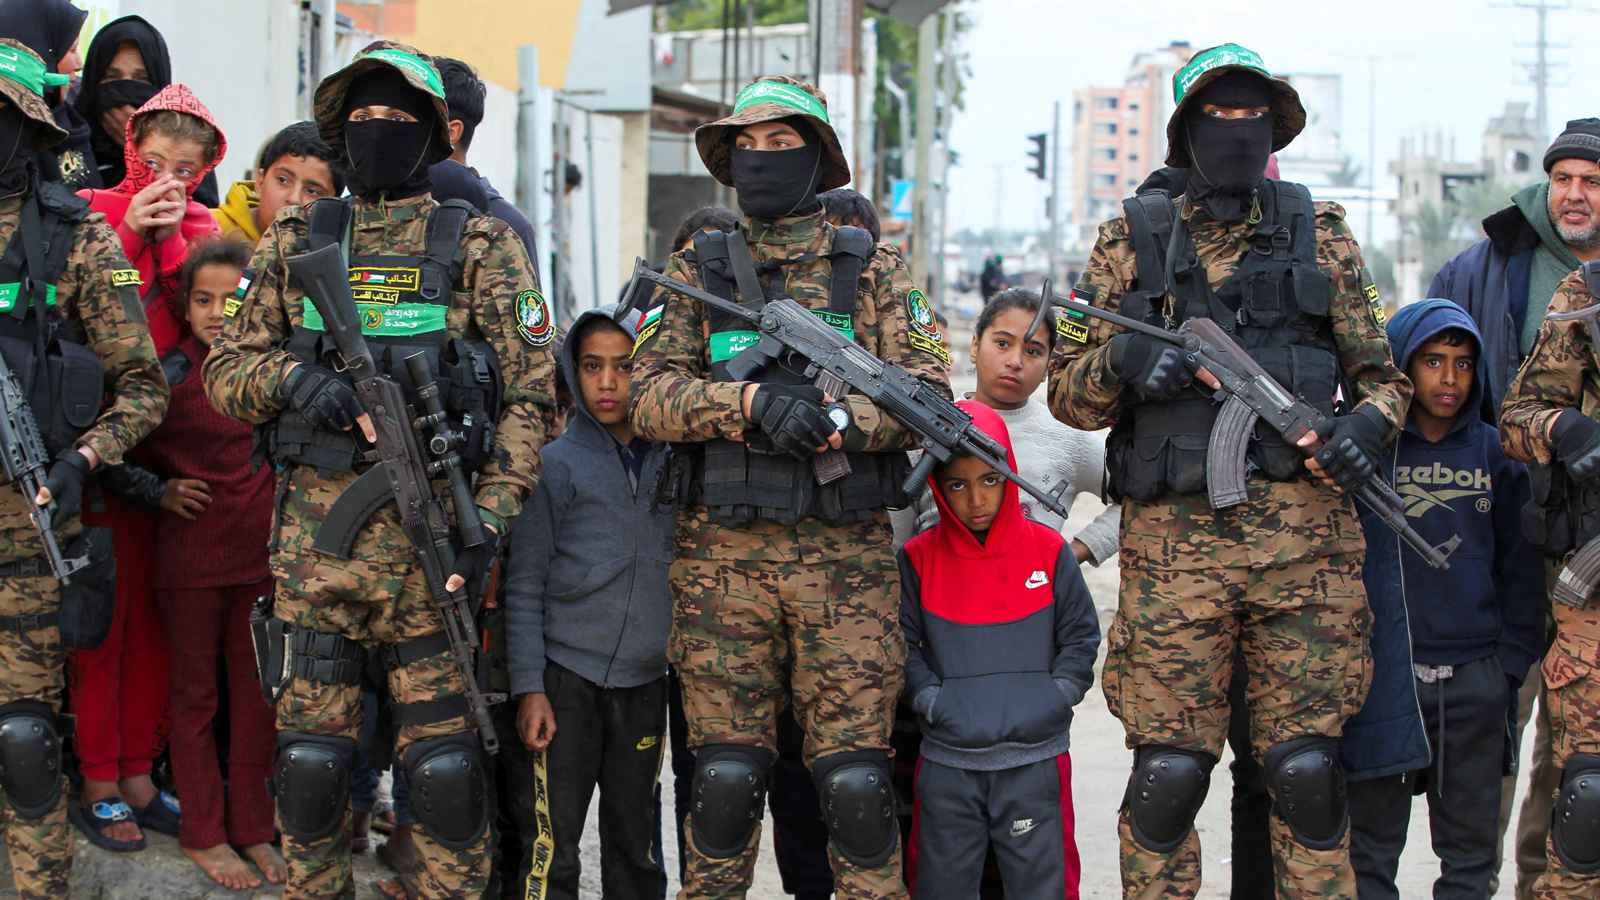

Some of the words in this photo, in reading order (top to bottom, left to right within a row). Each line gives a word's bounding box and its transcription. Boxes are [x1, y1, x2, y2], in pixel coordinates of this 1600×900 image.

[1396, 461, 1492, 490] eebok
[1013, 818, 1032, 830] NIKE
[535, 842, 549, 872] NIKE
